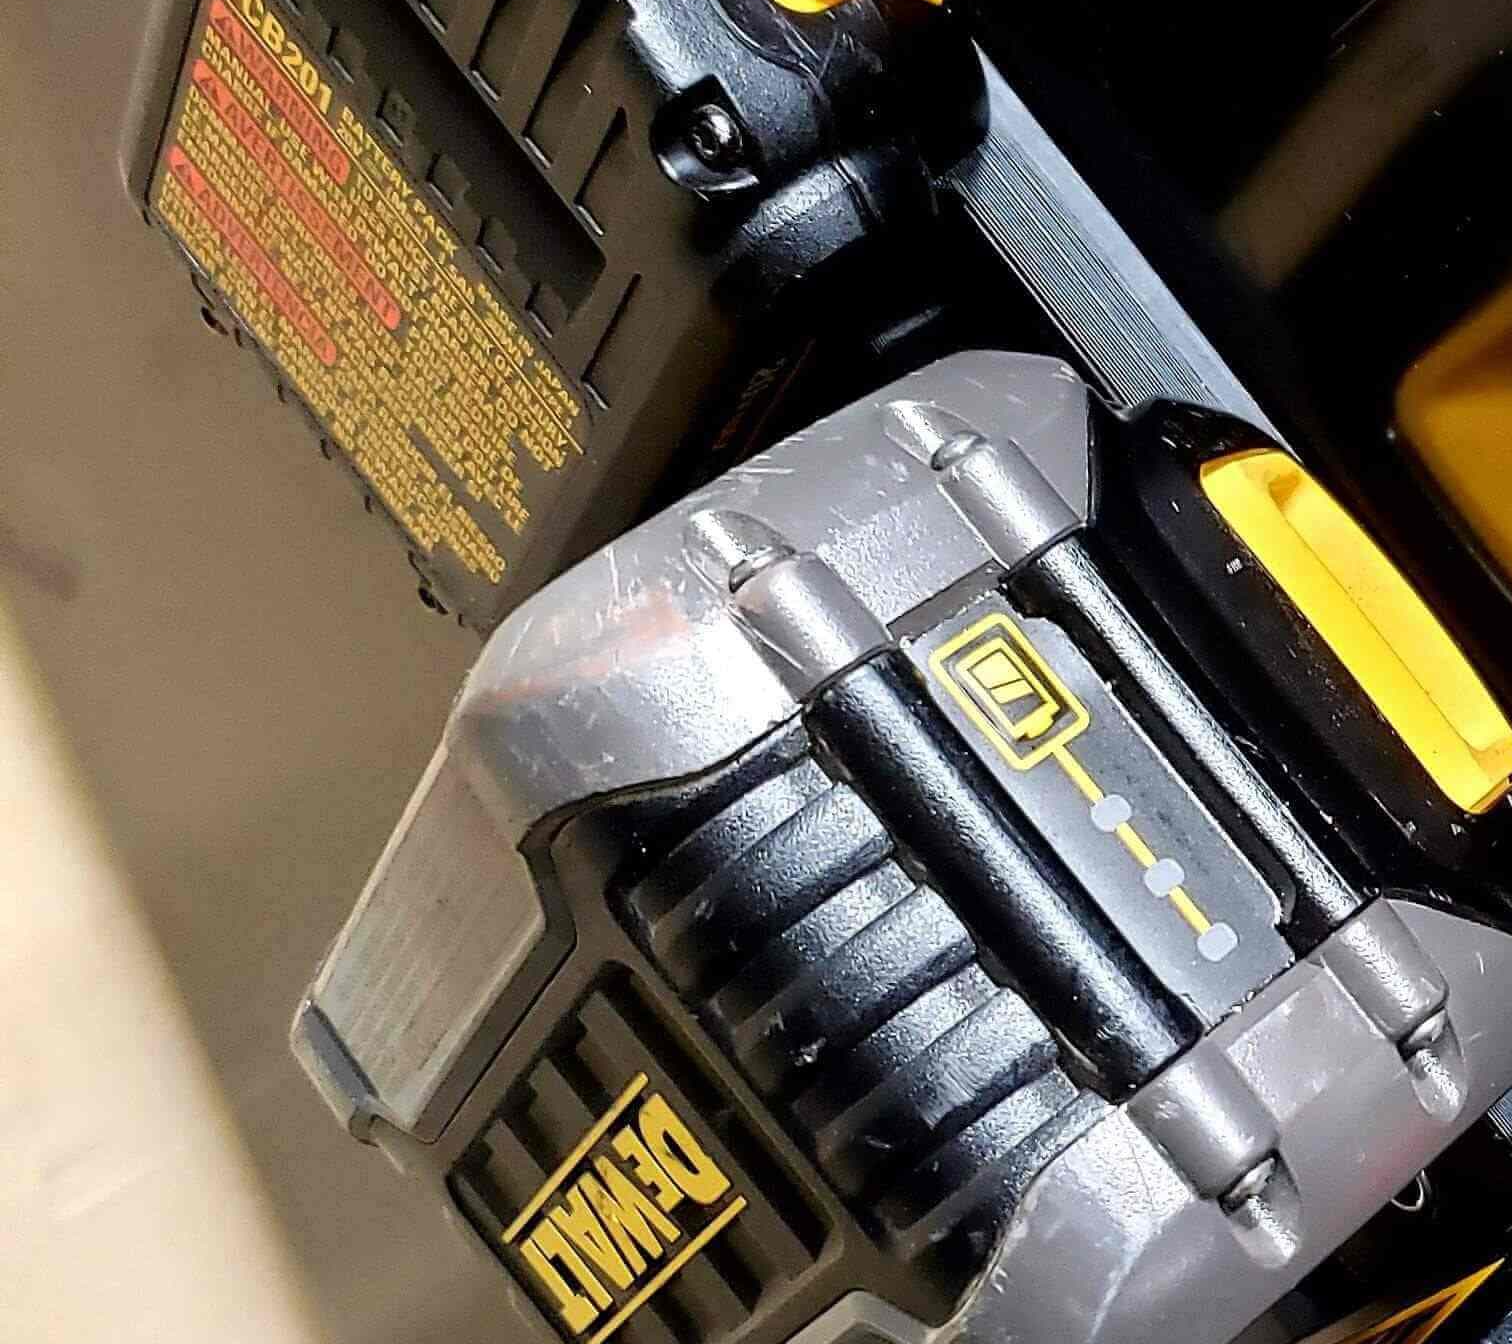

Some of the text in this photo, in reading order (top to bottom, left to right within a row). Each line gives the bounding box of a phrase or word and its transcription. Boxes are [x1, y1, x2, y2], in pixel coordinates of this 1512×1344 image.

[201, 36, 264, 125] CHARGE
[264, 118, 278, 142] IF
[363, 245, 388, 282] DO
[387, 277, 422, 326] NOT
[223, 94, 398, 326] AVERTISSEMENT
[235, 25, 347, 182] WARNING
[197, 180, 332, 359] ADVERTENCIA
[279, 116, 310, 164] USE
[310, 157, 353, 217] WITH
[493, 395, 520, 431] DO
[518, 427, 555, 476] NOT
[335, 119, 363, 161] 20V
[532, 374, 567, 421] TYPE
[340, 104, 580, 418] BATTERY PACK MADE IN JAPAN
[346, 323, 379, 370] PAS
[348, 185, 566, 469] USER MUST READ INSTRUCTION
[353, 171, 572, 457] TO REDUCE THE RISK OF INJURY,
[408, 324, 452, 384] POUR
[338, 354, 379, 409] PARA
[401, 336, 524, 496] TOUT RISQUE DE
[461, 434, 498, 483] DOIT
[519, 1092, 733, 1336] DEWALT
